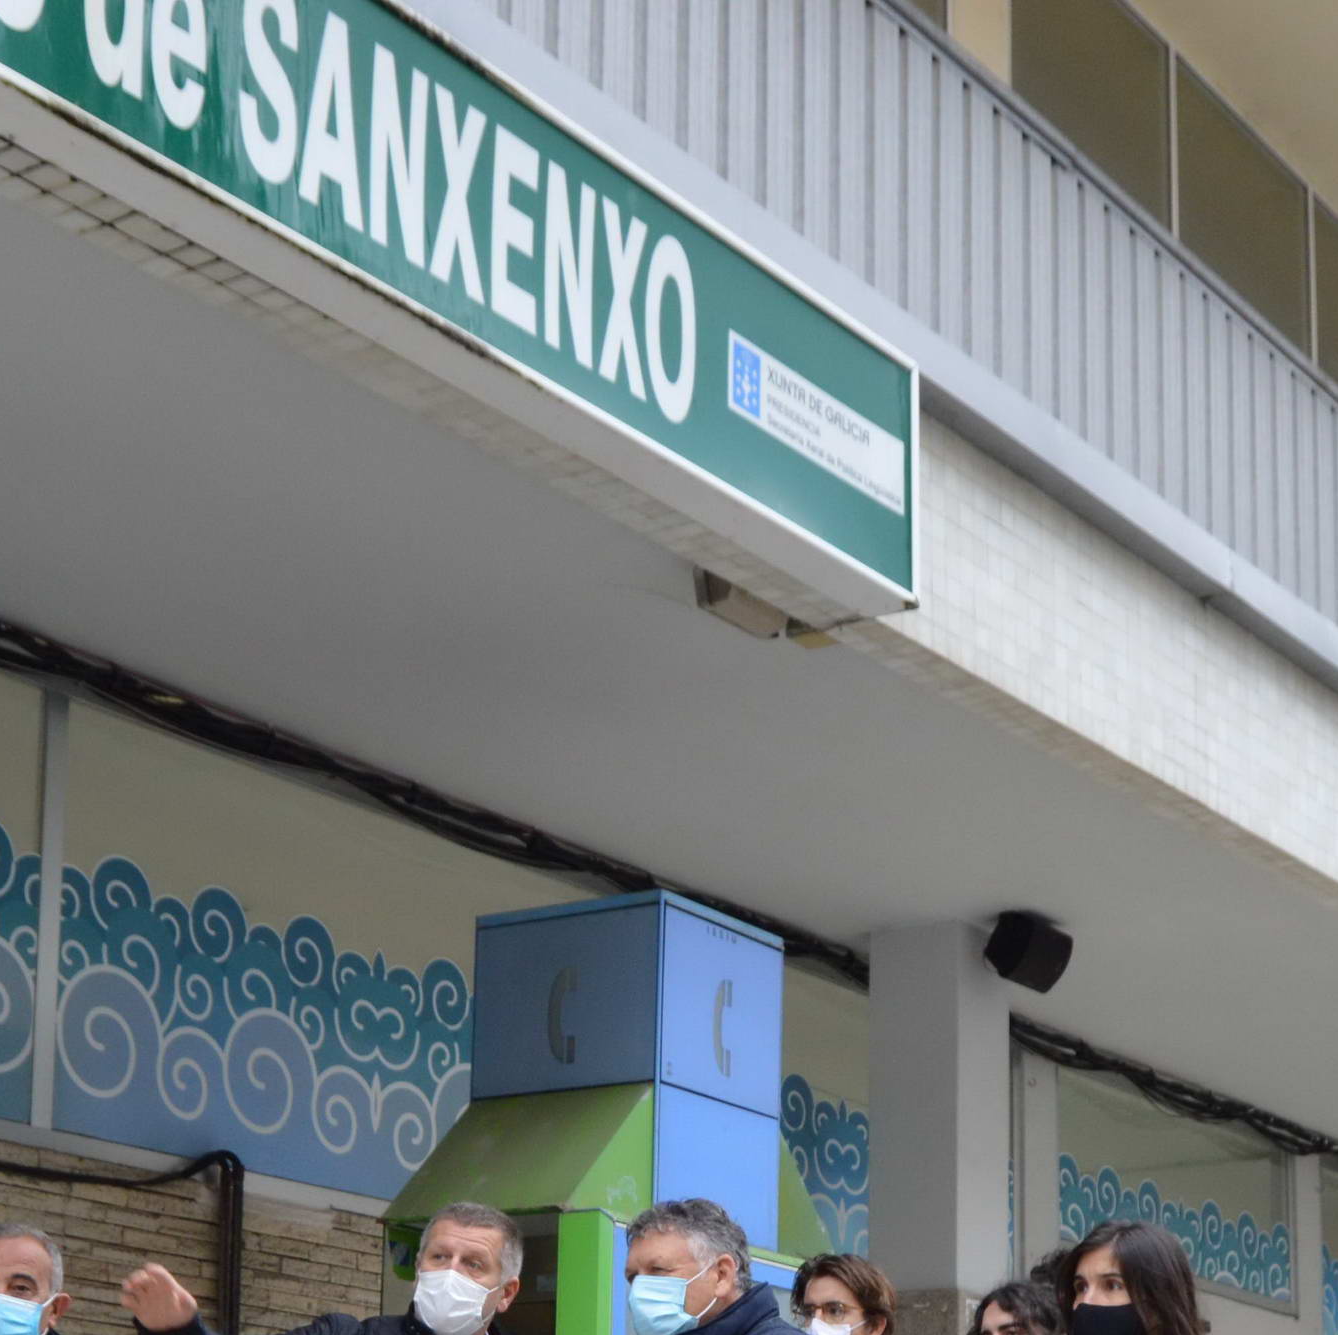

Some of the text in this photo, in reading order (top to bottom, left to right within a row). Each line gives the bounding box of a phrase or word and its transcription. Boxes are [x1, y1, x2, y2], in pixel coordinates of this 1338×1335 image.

[84, 0, 697, 424] de SANXENXO
[767, 365, 870, 448] XUNTA DE GALICIA
